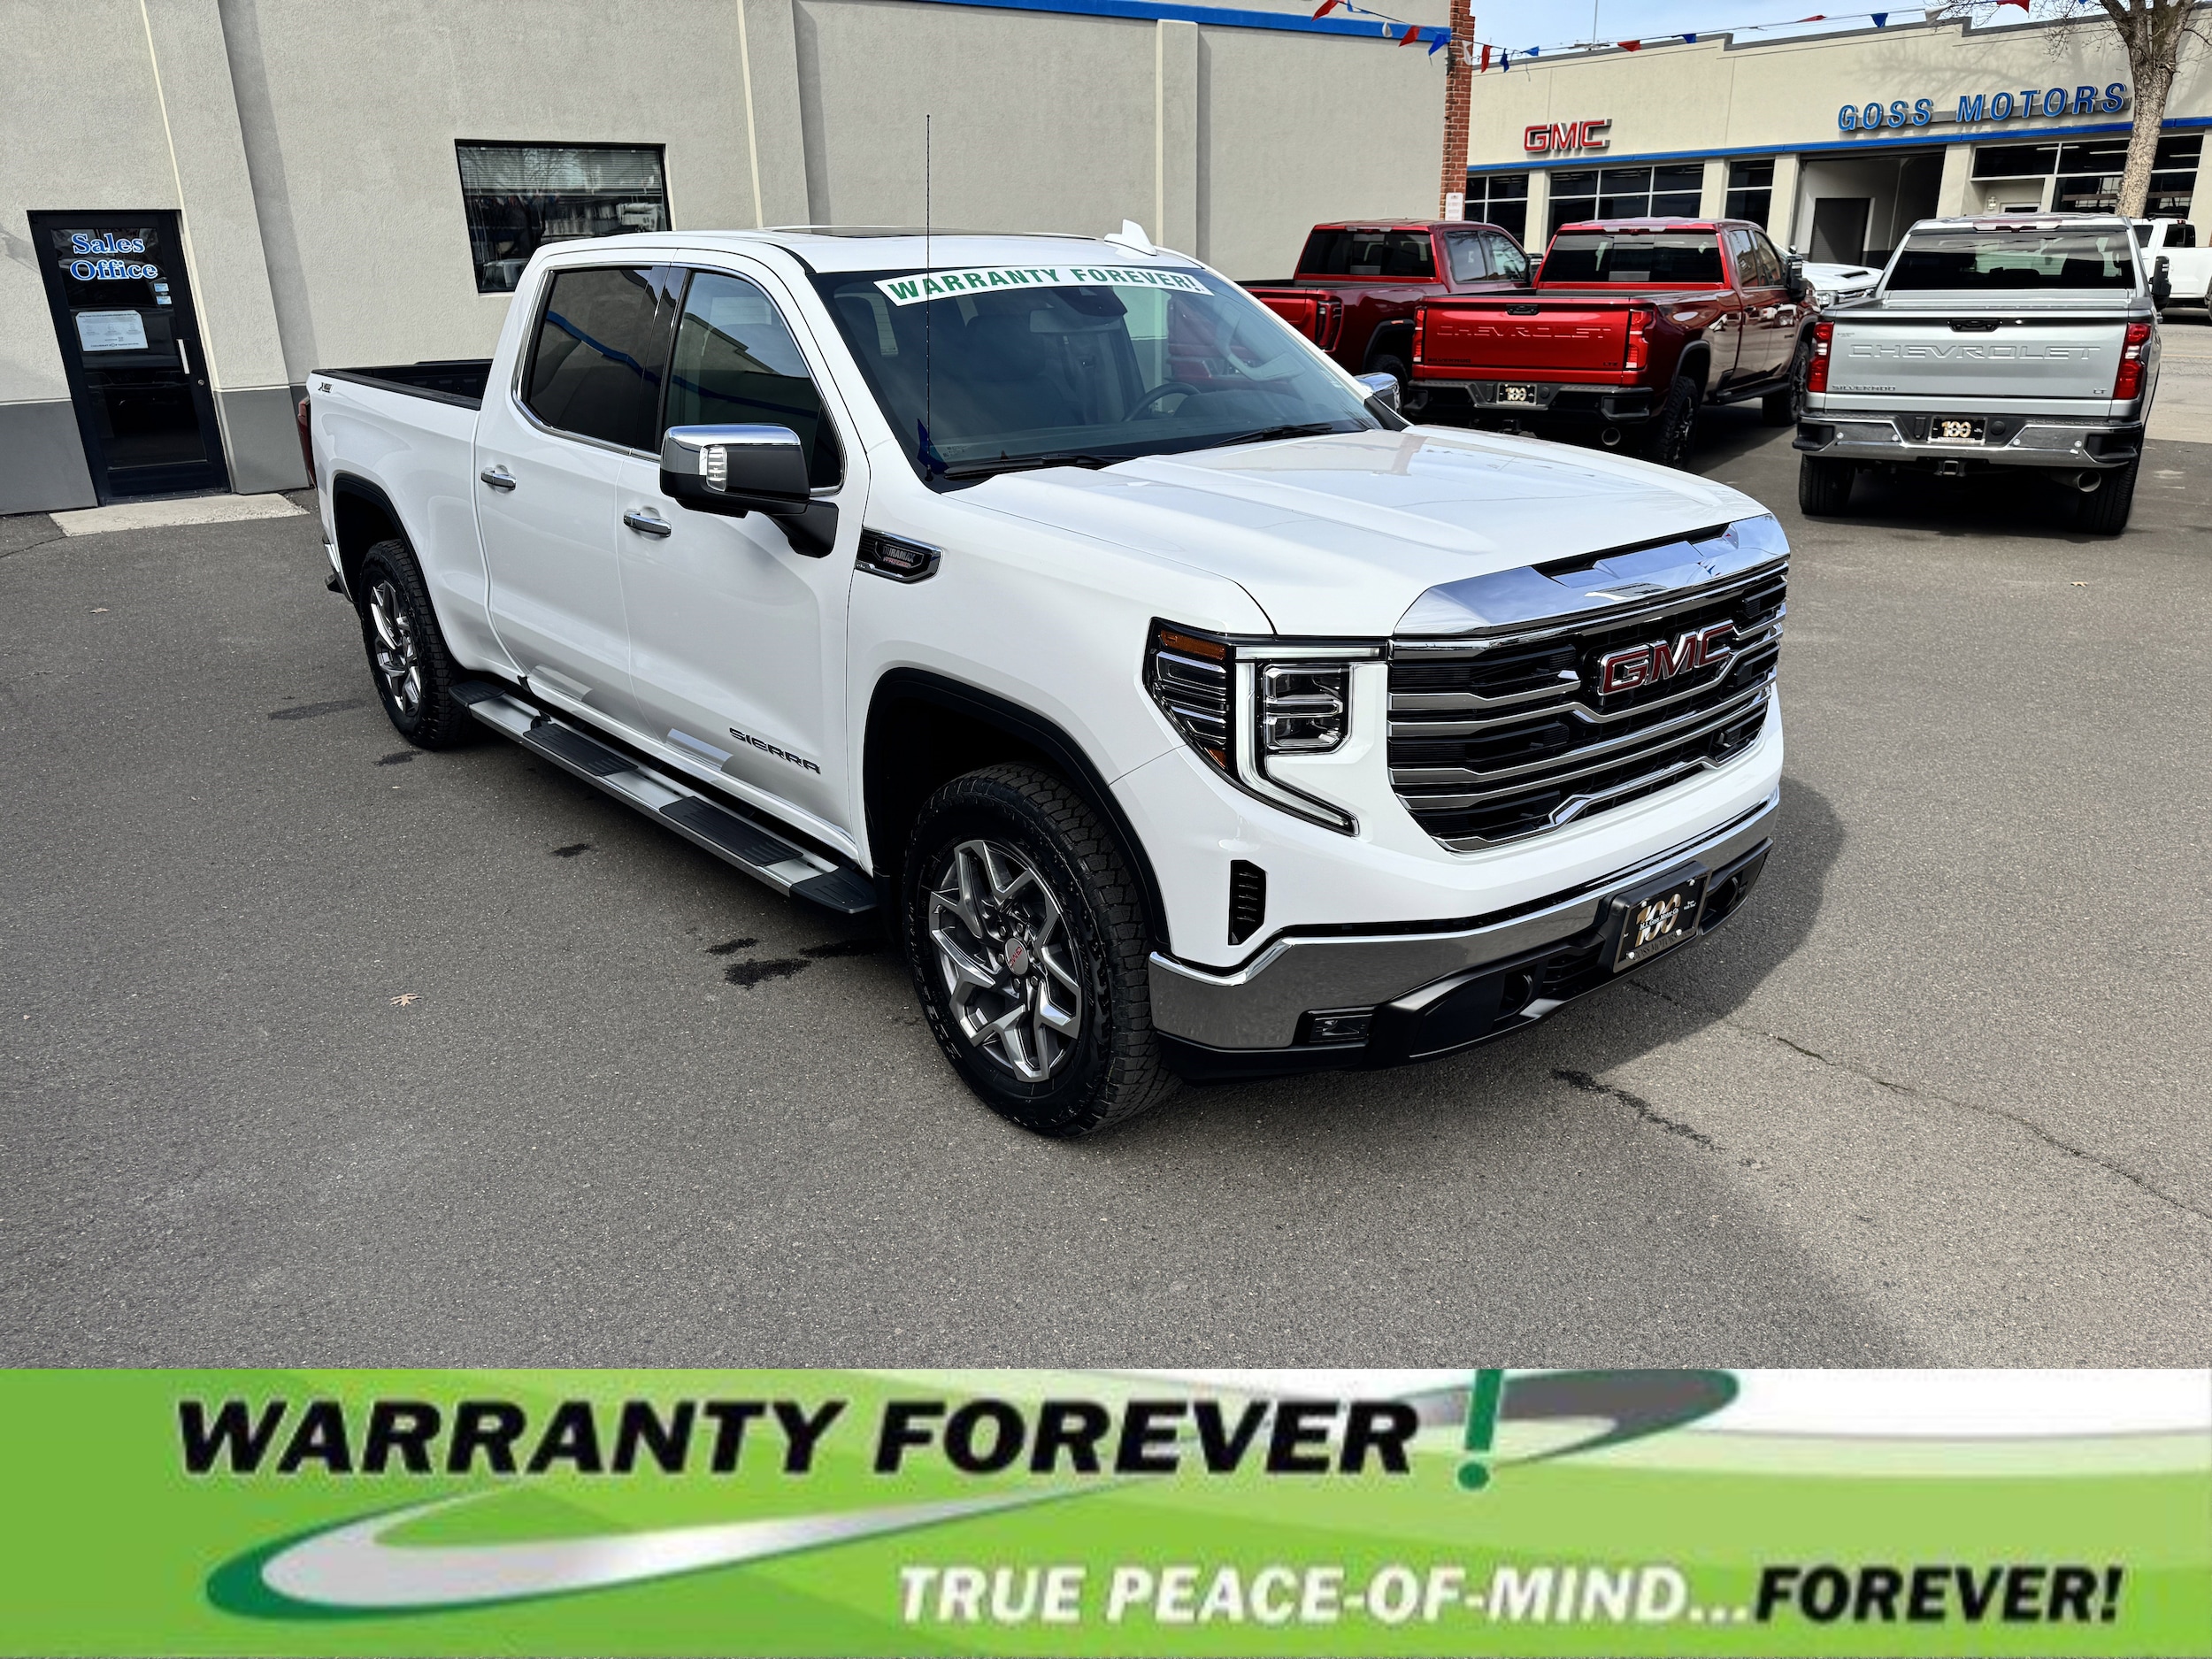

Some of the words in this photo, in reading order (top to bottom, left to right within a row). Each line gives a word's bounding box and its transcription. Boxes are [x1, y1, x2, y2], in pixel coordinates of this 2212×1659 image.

[1838, 98, 1934, 132] GOSS
[1955, 82, 2127, 122] MOTORS
[1524, 119, 1610, 151] GMC
[72, 233, 145, 254] Sales
[70, 259, 158, 280] Office
[887, 268, 1061, 300] WARRANTY
[1070, 268, 1202, 292] FOREVER!
[1437, 326, 1612, 339] CHEVROLET
[1848, 344, 2101, 360] CHEVROLET
[1941, 420, 1972, 438] 100
[1597, 618, 1734, 696] GMC
[728, 726, 821, 775] SIERRA
[1635, 893, 1681, 948] 100
